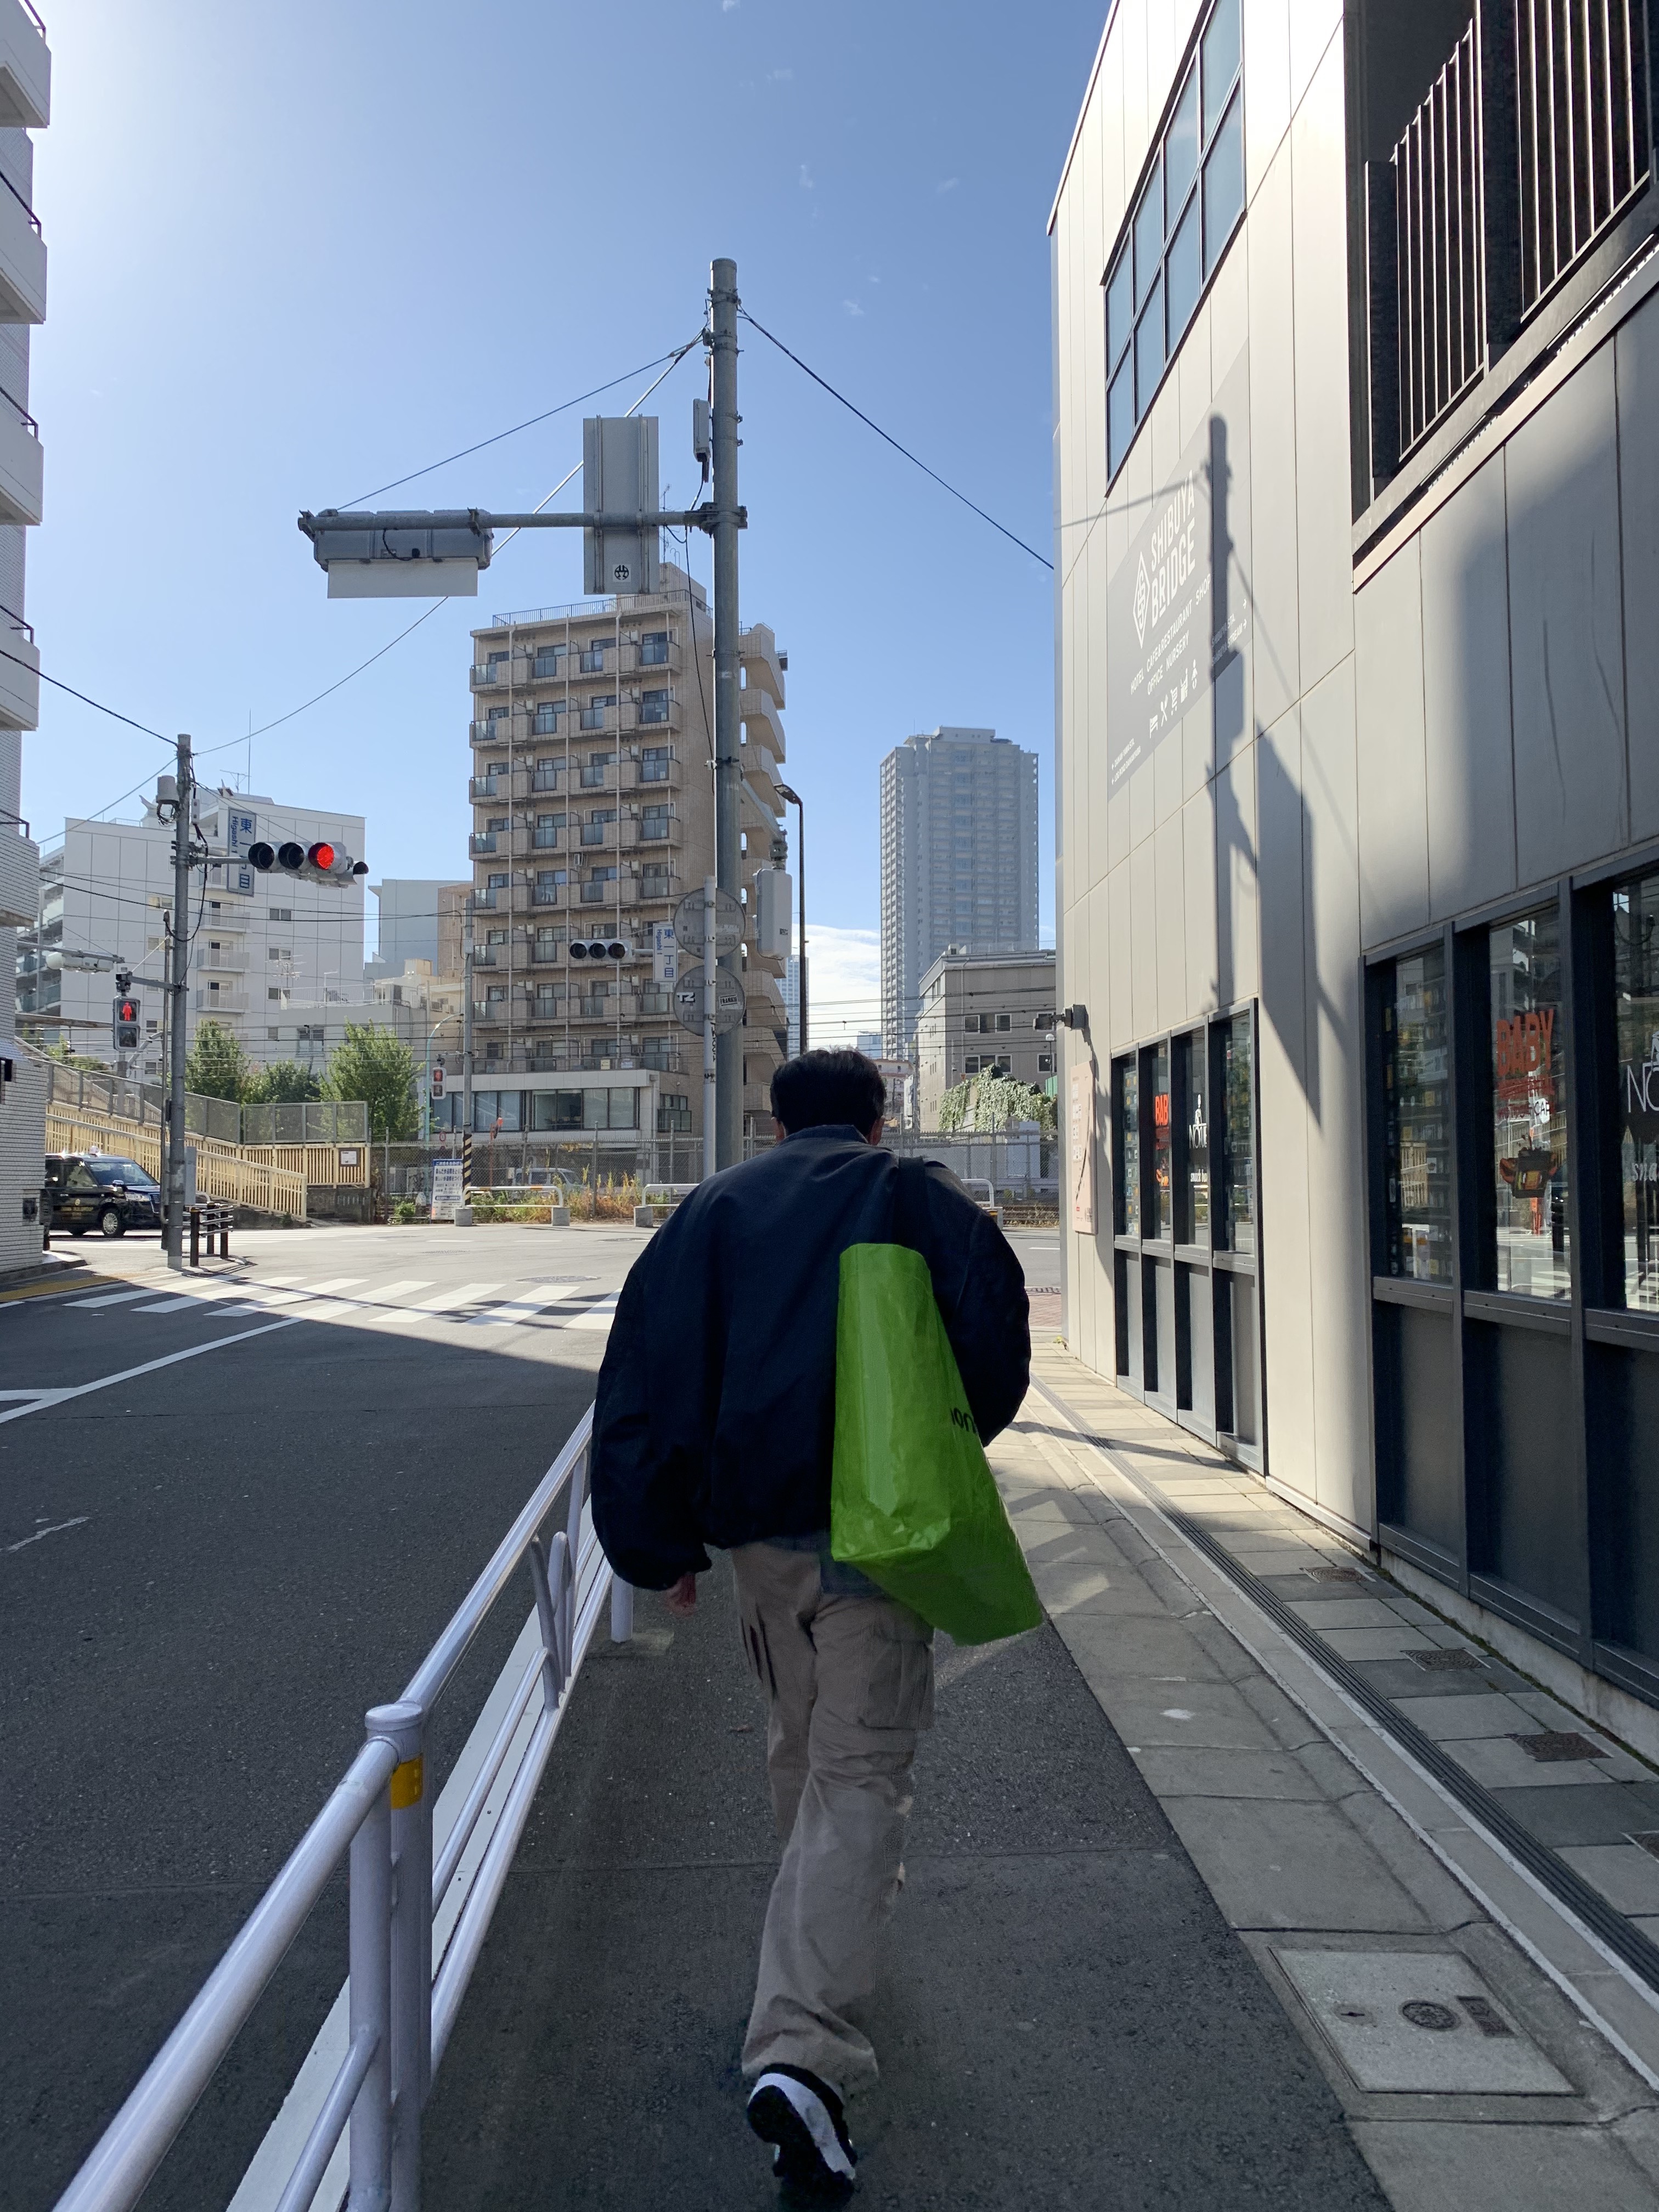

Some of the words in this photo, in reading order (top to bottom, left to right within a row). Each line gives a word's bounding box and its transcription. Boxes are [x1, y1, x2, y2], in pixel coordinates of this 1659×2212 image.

[1152, 469, 1195, 572] SHIBUYA
[1152, 517, 1195, 629] BRIDGE
[1131, 668, 1144, 695] HOTEL
[1147, 599, 1193, 673] CAFE&RESTAURANT
[1195, 573, 1211, 606] SHOP
[1147, 664, 1164, 696] OFFICE
[1166, 630, 1189, 672] NURSERY
[664, 929, 675, 978] 東一丁目
[1496, 1008, 1554, 1077] BABY
[1155, 1093, 1169, 1126] BAB
